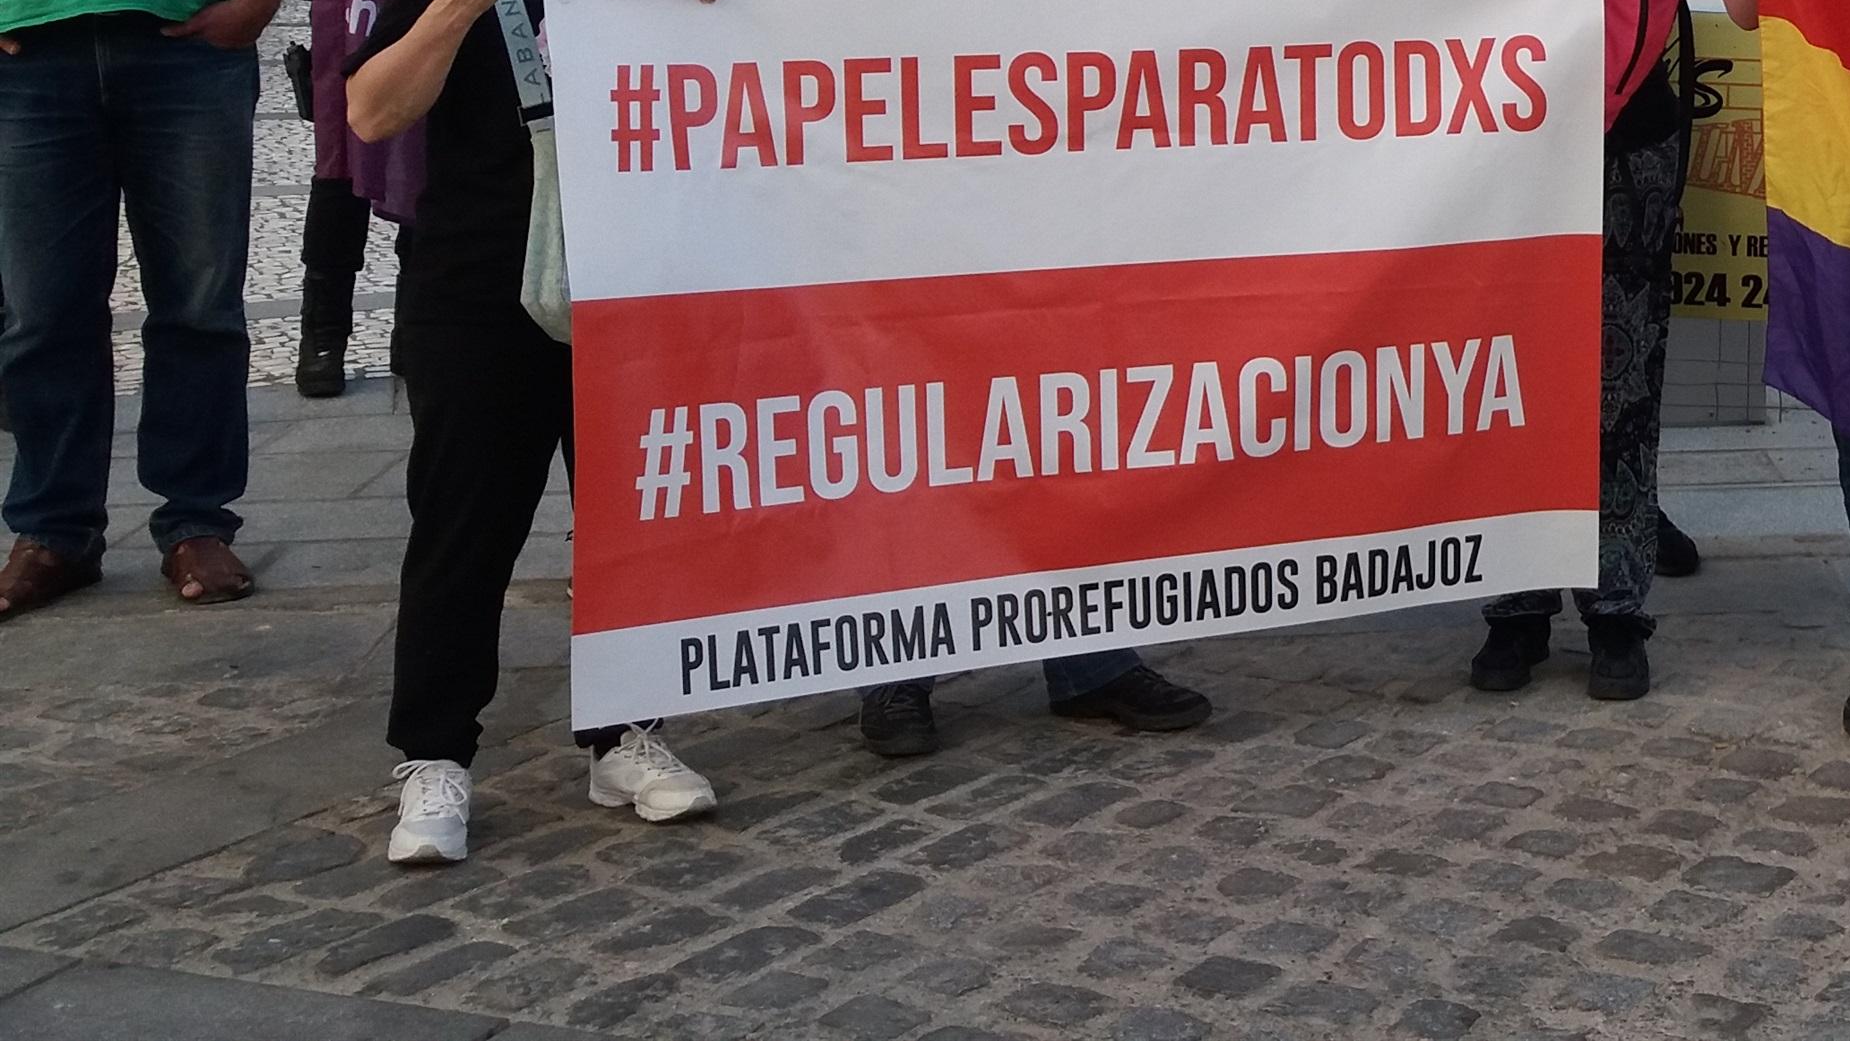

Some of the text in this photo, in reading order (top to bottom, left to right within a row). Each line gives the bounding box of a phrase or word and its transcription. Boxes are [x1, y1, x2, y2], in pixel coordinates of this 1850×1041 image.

[610, 34, 1548, 172] #PAPELESPARATODXS
[1728, 235, 1742, 256] Y
[635, 334, 1526, 521] #REGULARIZACIONYA
[680, 602, 956, 695] PLATAFORMA
[1316, 534, 1483, 605] BADAJOZ
